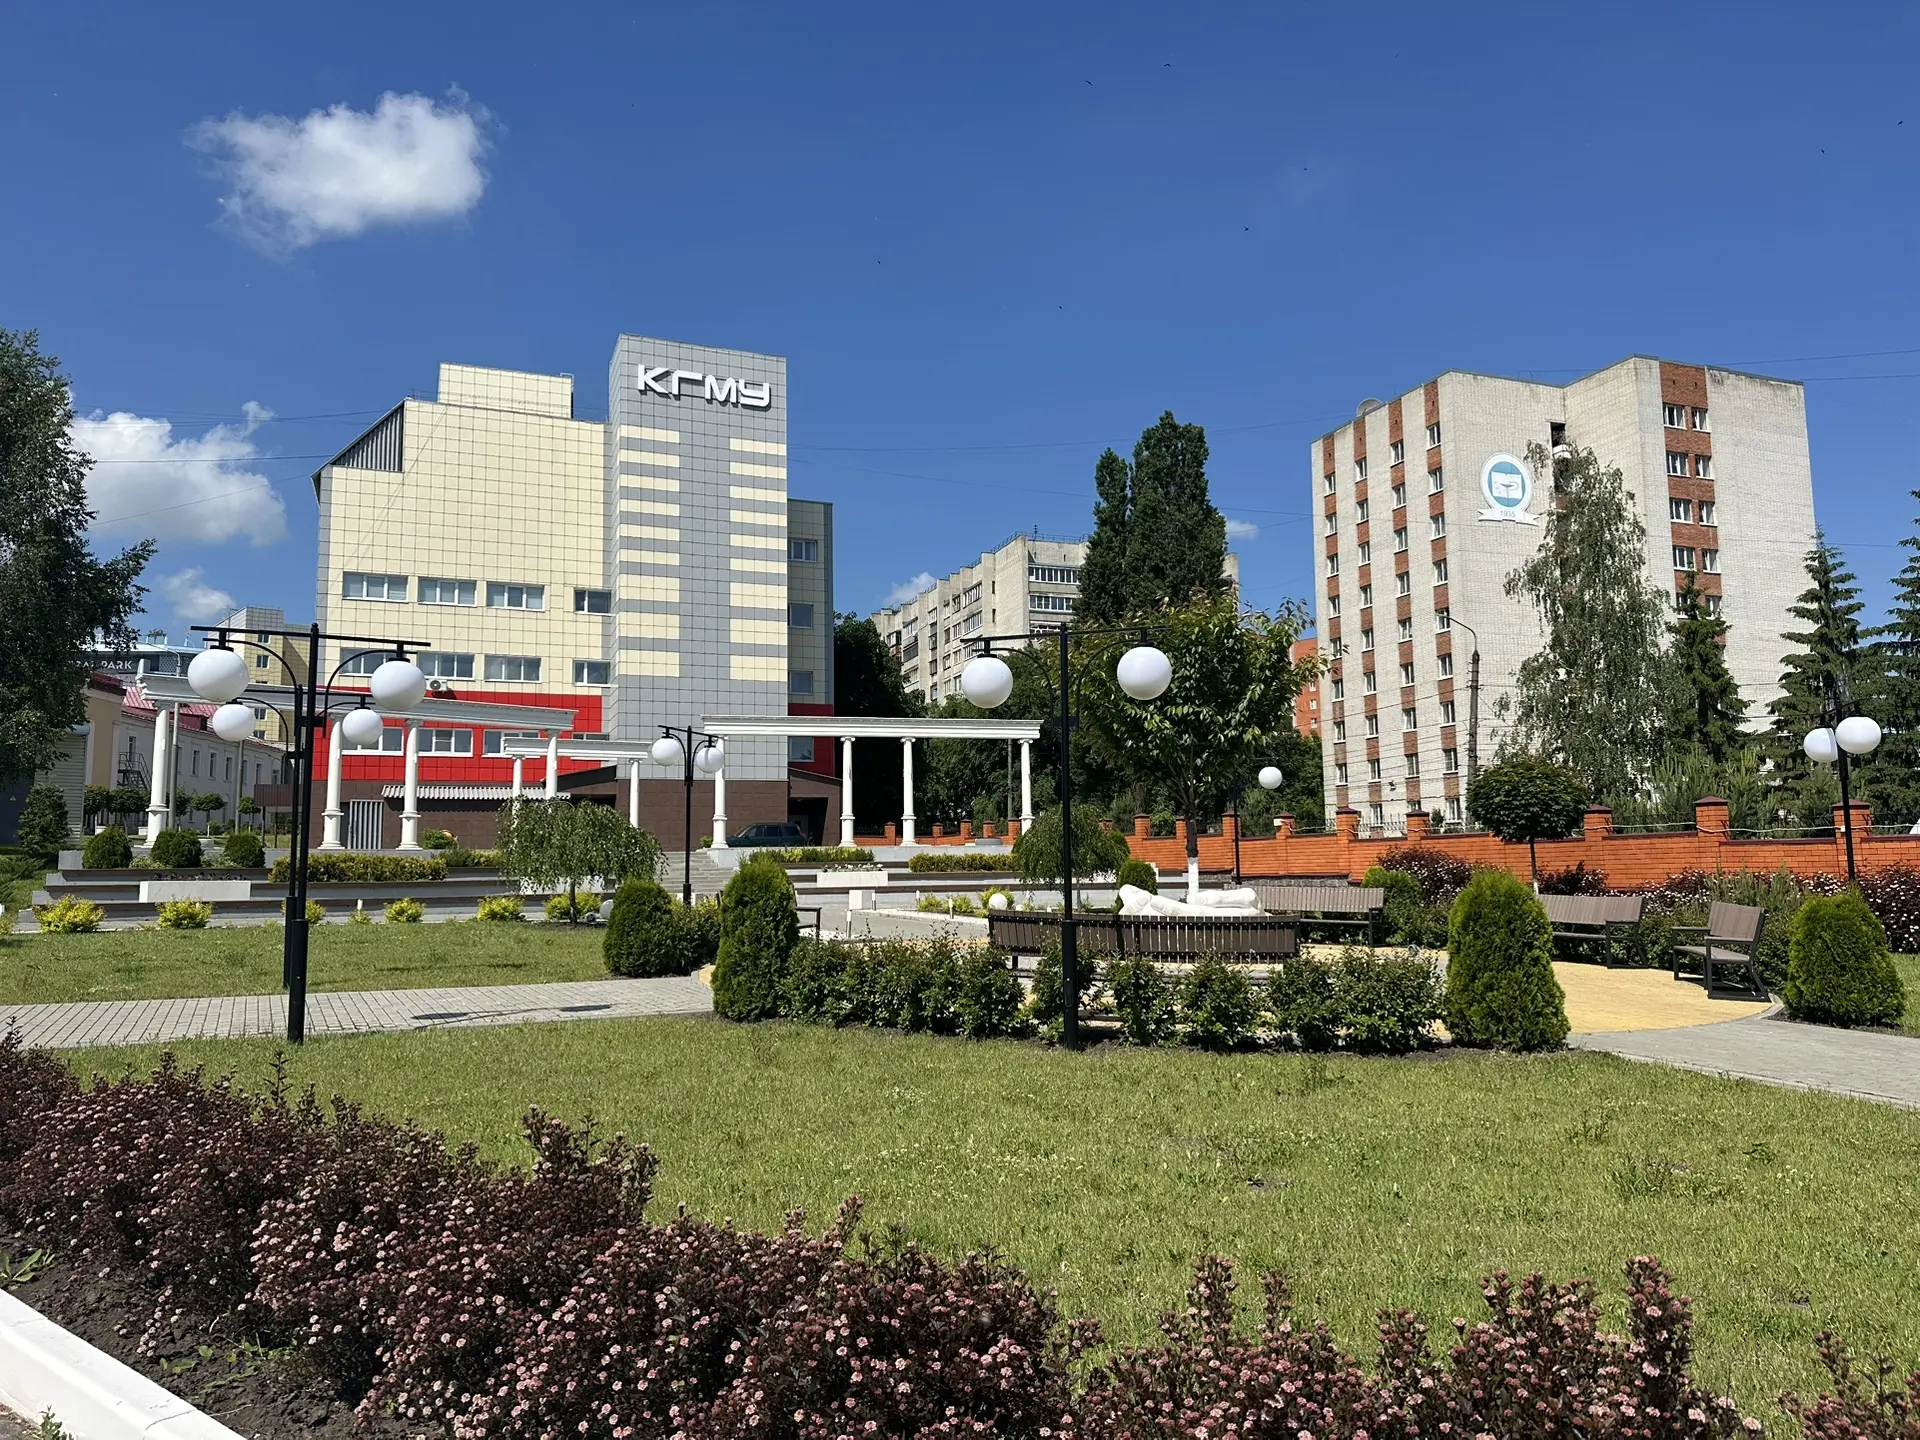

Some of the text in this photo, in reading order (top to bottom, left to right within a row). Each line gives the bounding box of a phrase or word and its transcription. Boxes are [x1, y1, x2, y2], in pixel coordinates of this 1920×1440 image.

[637, 364, 770, 408] КГМУ
[1500, 510, 1516, 518] 1935
[101, 660, 133, 670] PARK
